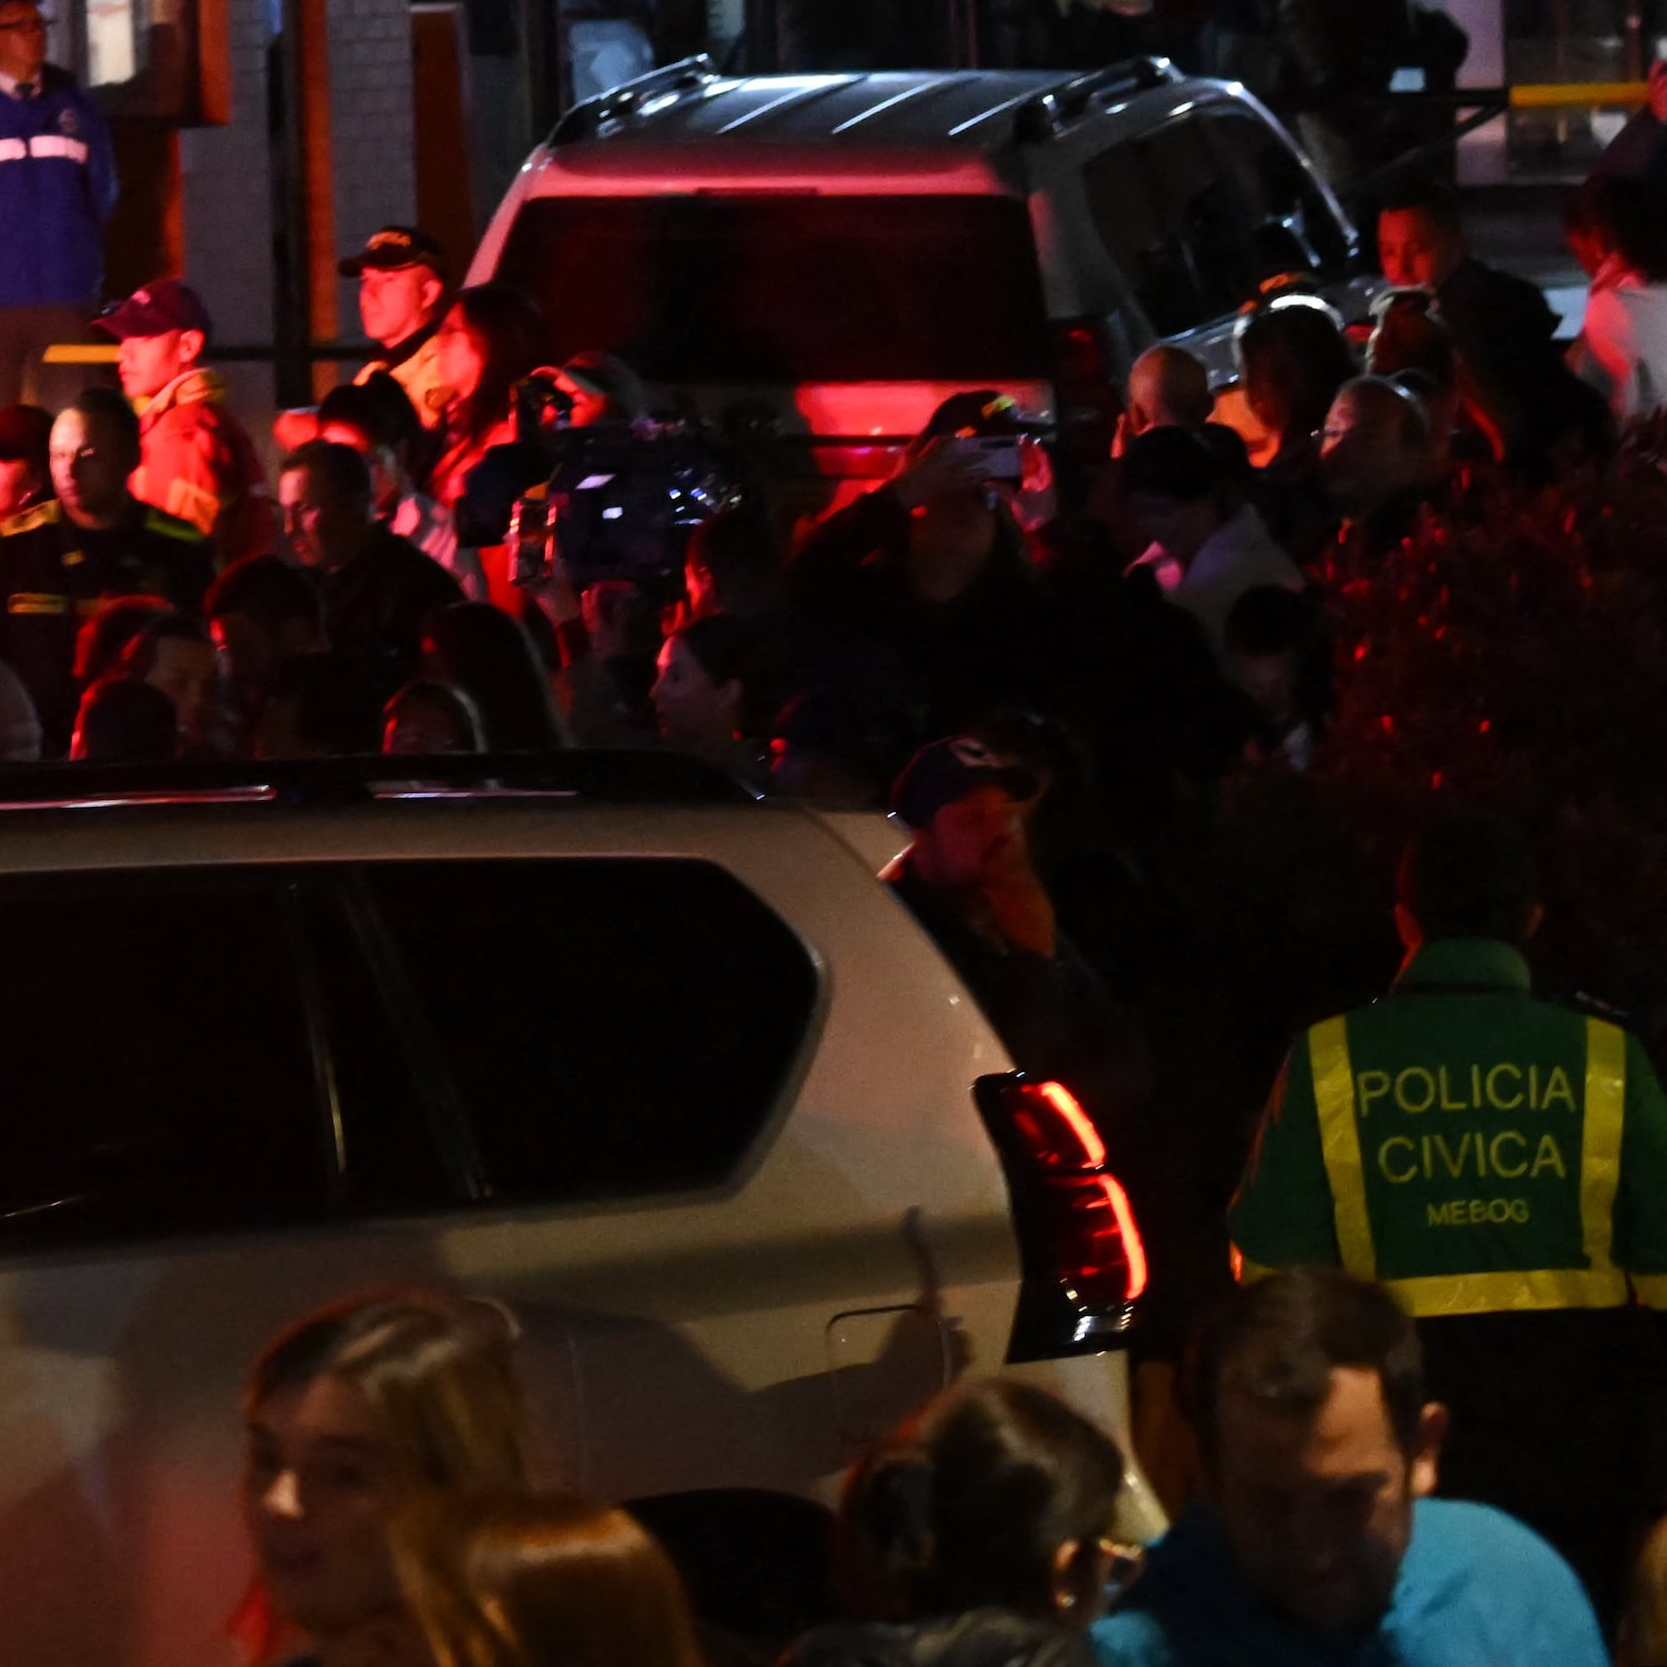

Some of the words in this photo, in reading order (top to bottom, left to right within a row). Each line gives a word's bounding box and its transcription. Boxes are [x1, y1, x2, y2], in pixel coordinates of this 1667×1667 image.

[1356, 1062, 1578, 1119] POLICIA
[1377, 1130, 1568, 1185] CIVICA
[1426, 1198, 1532, 1227] MEBOG
